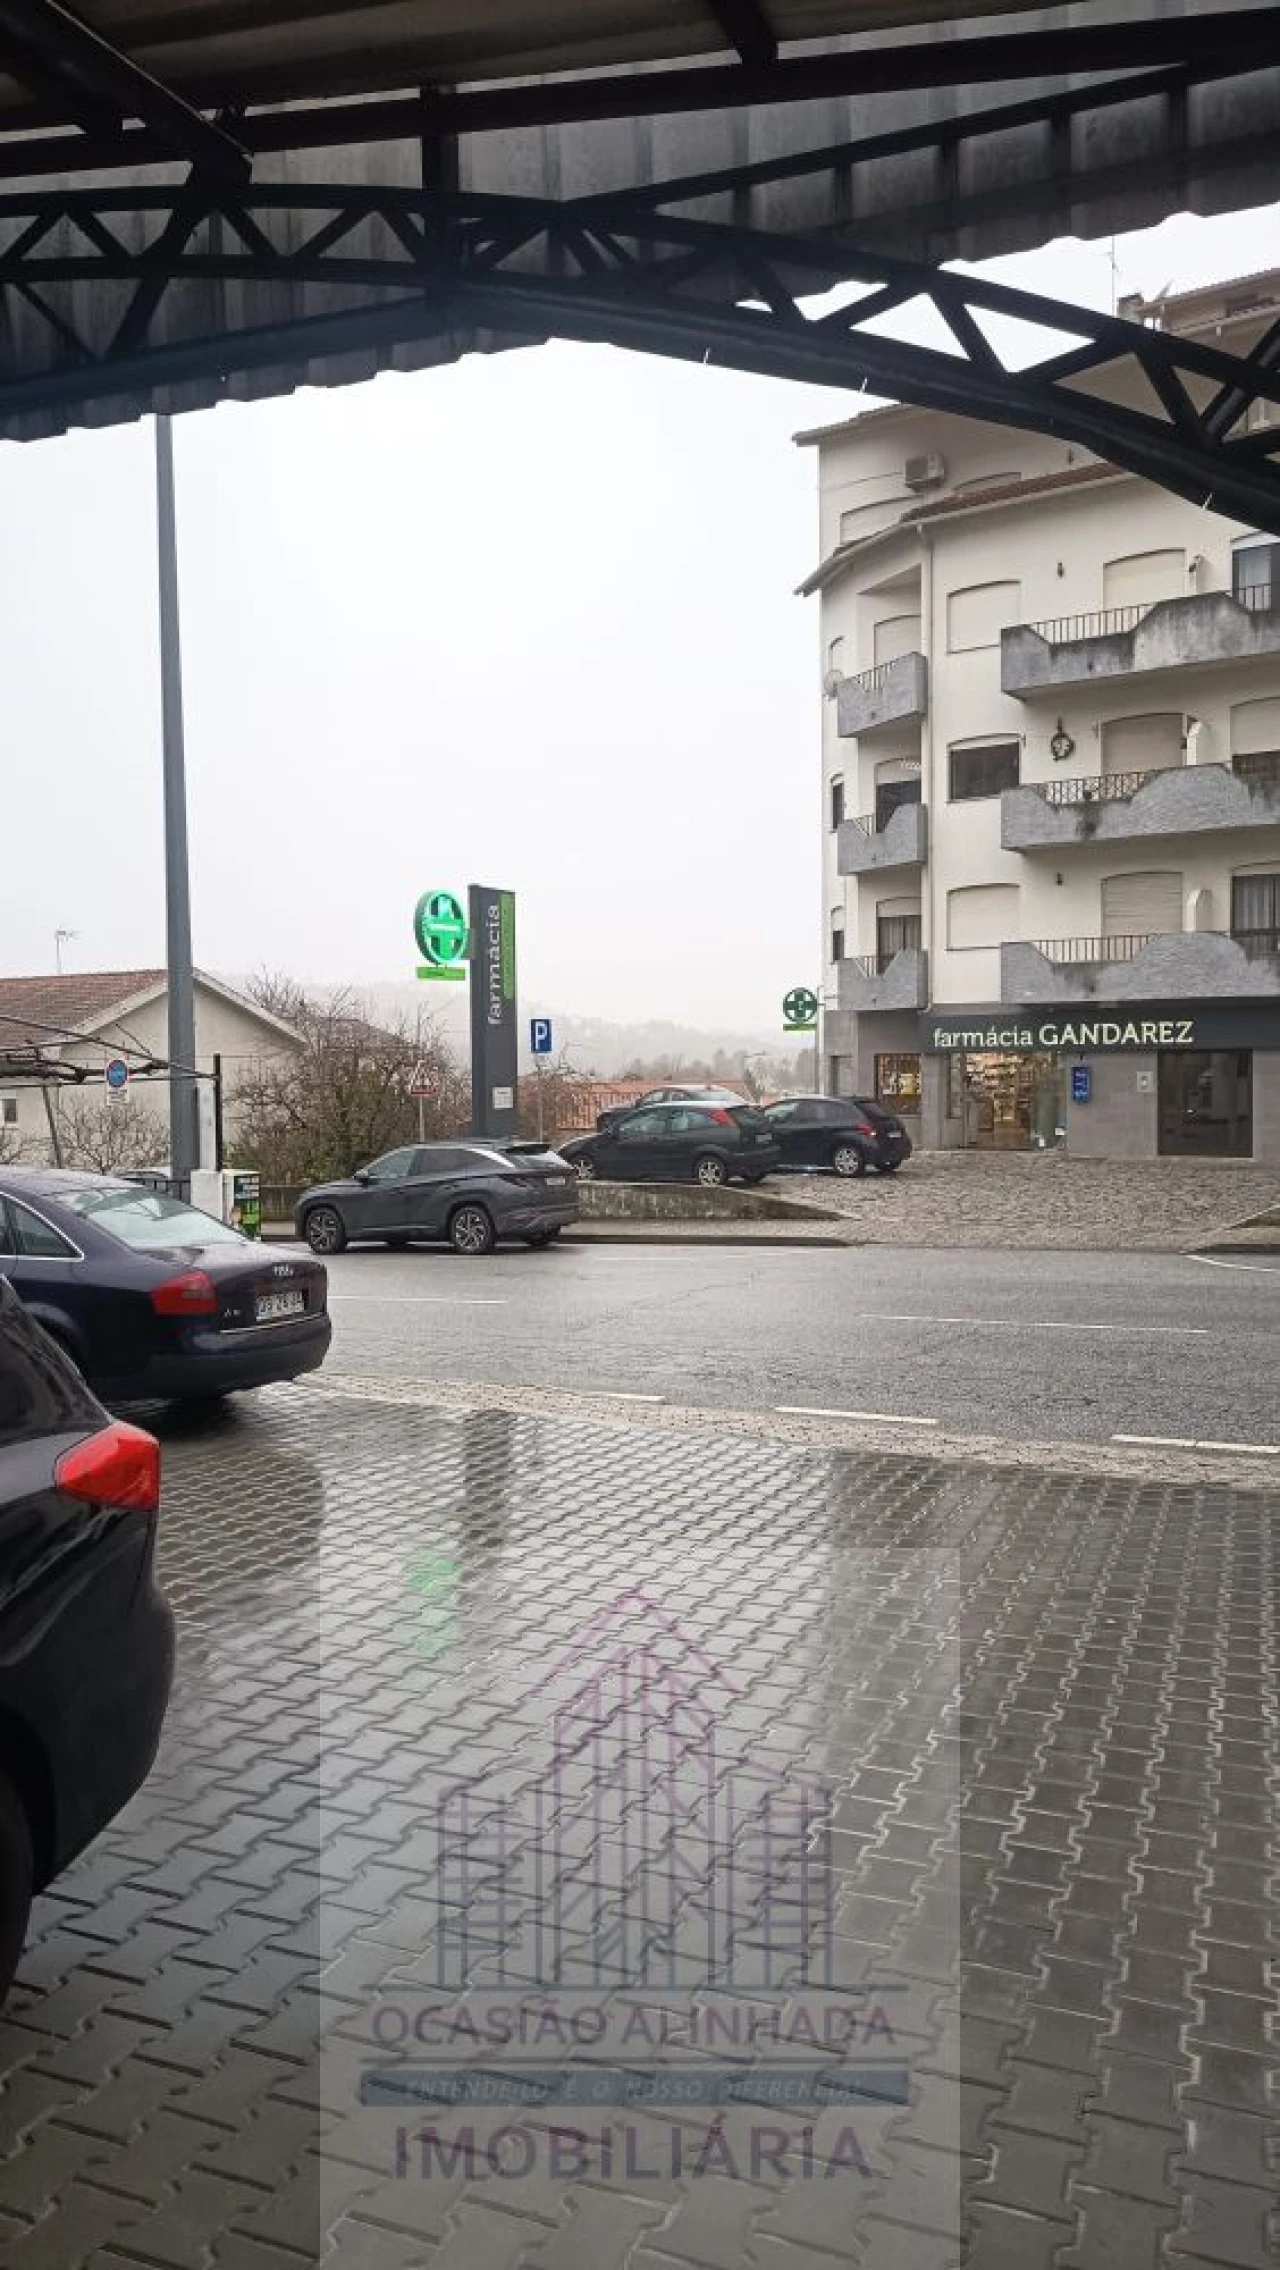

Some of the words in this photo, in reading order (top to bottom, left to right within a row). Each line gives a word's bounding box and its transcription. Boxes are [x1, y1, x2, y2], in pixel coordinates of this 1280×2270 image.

[535, 1021, 548, 1050] P
[933, 1025, 1033, 1047] farmácia
[1039, 1021, 1194, 1045] GANDAREZ
